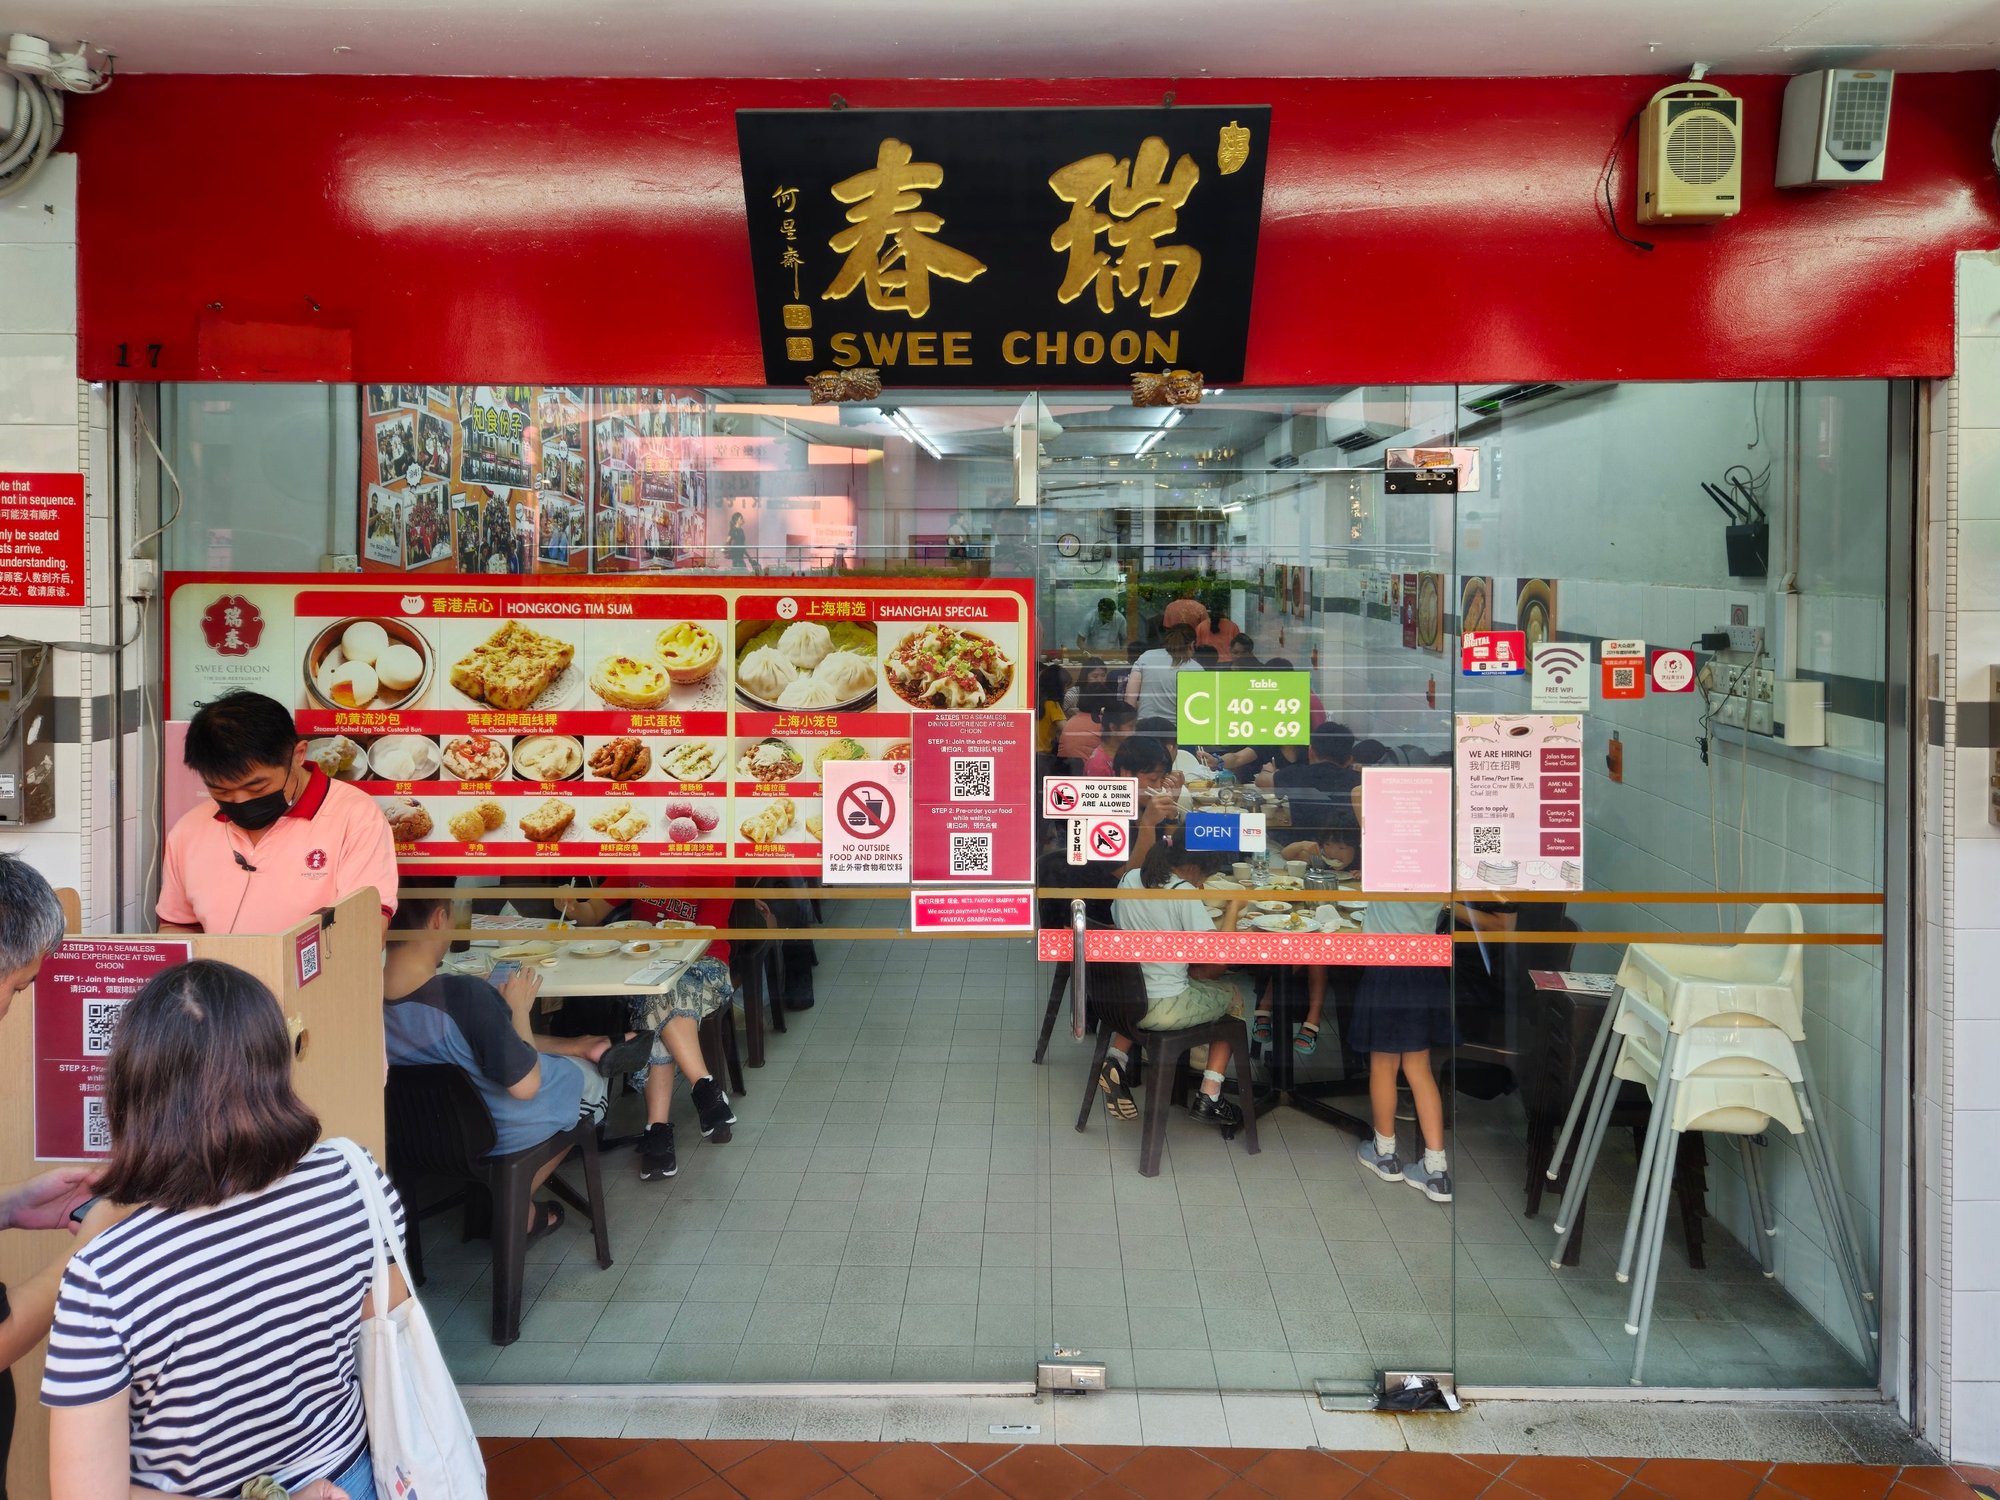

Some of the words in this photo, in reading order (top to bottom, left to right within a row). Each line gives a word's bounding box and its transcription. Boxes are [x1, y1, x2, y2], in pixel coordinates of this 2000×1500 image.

[831, 330, 973, 367] SWEE
[1002, 330, 1179, 367] CHOON
[472, 404, 523, 441] 知食份子
[12, 480, 30, 491] that
[2, 494, 16, 505] not
[19, 494, 27, 504] in
[29, 496, 76, 507] sequence.
[15, 530, 26, 540] be
[29, 530, 59, 540] seated
[15, 543, 43, 554] arrive.
[0, 557, 68, 570] understanding.
[433, 598, 494, 613] 香港点心
[507, 603, 581, 615] HONGKONG
[584, 603, 604, 615] TIM
[608, 603, 632, 615] SUM
[806, 601, 866, 617] 上海精选
[880, 606, 941, 617] SHANGHAI
[945, 606, 988, 617] SPECIAL
[224, 607, 243, 649] 瑞春
[1463, 636, 1490, 648] DIGITAL
[194, 664, 223, 673] SWEE
[226, 664, 270, 673] CHOON
[1250, 679, 1277, 688] Table
[1184, 691, 1210, 725] C
[1227, 698, 1254, 714] 40
[1273, 698, 1300, 714] 49
[335, 713, 400, 725] 奶黄流沙包
[467, 713, 557, 726] 瑞春招牌面线粿
[631, 714, 681, 727] 葡式蛋挞
[775, 715, 838, 727] 上海小笼包
[314, 726, 339, 734] Steamed
[340, 726, 361, 734] Salted
[362, 726, 372, 734] Egg
[373, 726, 385, 734] Yolk
[387, 726, 409, 734] Custard
[411, 726, 422, 734] Bun
[627, 727, 659, 735] Portuguese
[660, 727, 671, 735] Egg
[672, 727, 684, 735] Tart
[771, 728, 798, 736] Shanghai
[800, 728, 814, 736] Xiao
[815, 728, 828, 736] Long
[829, 728, 841, 736] Bao
[1227, 721, 1254, 738] 50
[1273, 721, 1301, 738] 69
[1469, 761, 1520, 771] 我们在招聘
[1194, 826, 1231, 838] OPEN
[1072, 852, 1082, 861] 推
[830, 863, 903, 872] 禁止外带食物和饮料
[63, 944, 67, 952] 2
[69, 944, 94, 952] STEPS
[95, 944, 106, 952] TO
[108, 944, 112, 952] A
[114, 944, 155, 952] SEAMLESS
[53, 952, 79, 960] DINING
[82, 952, 130, 960] EXPERIENCE
[132, 952, 141, 960] AT
[143, 952, 166, 960] SWEE
[54, 975, 74, 983] STEP
[76, 975, 84, 983] 1:
[85, 975, 101, 983] Join
[103, 975, 116, 983] the
[117, 975, 144, 983] dine-in
